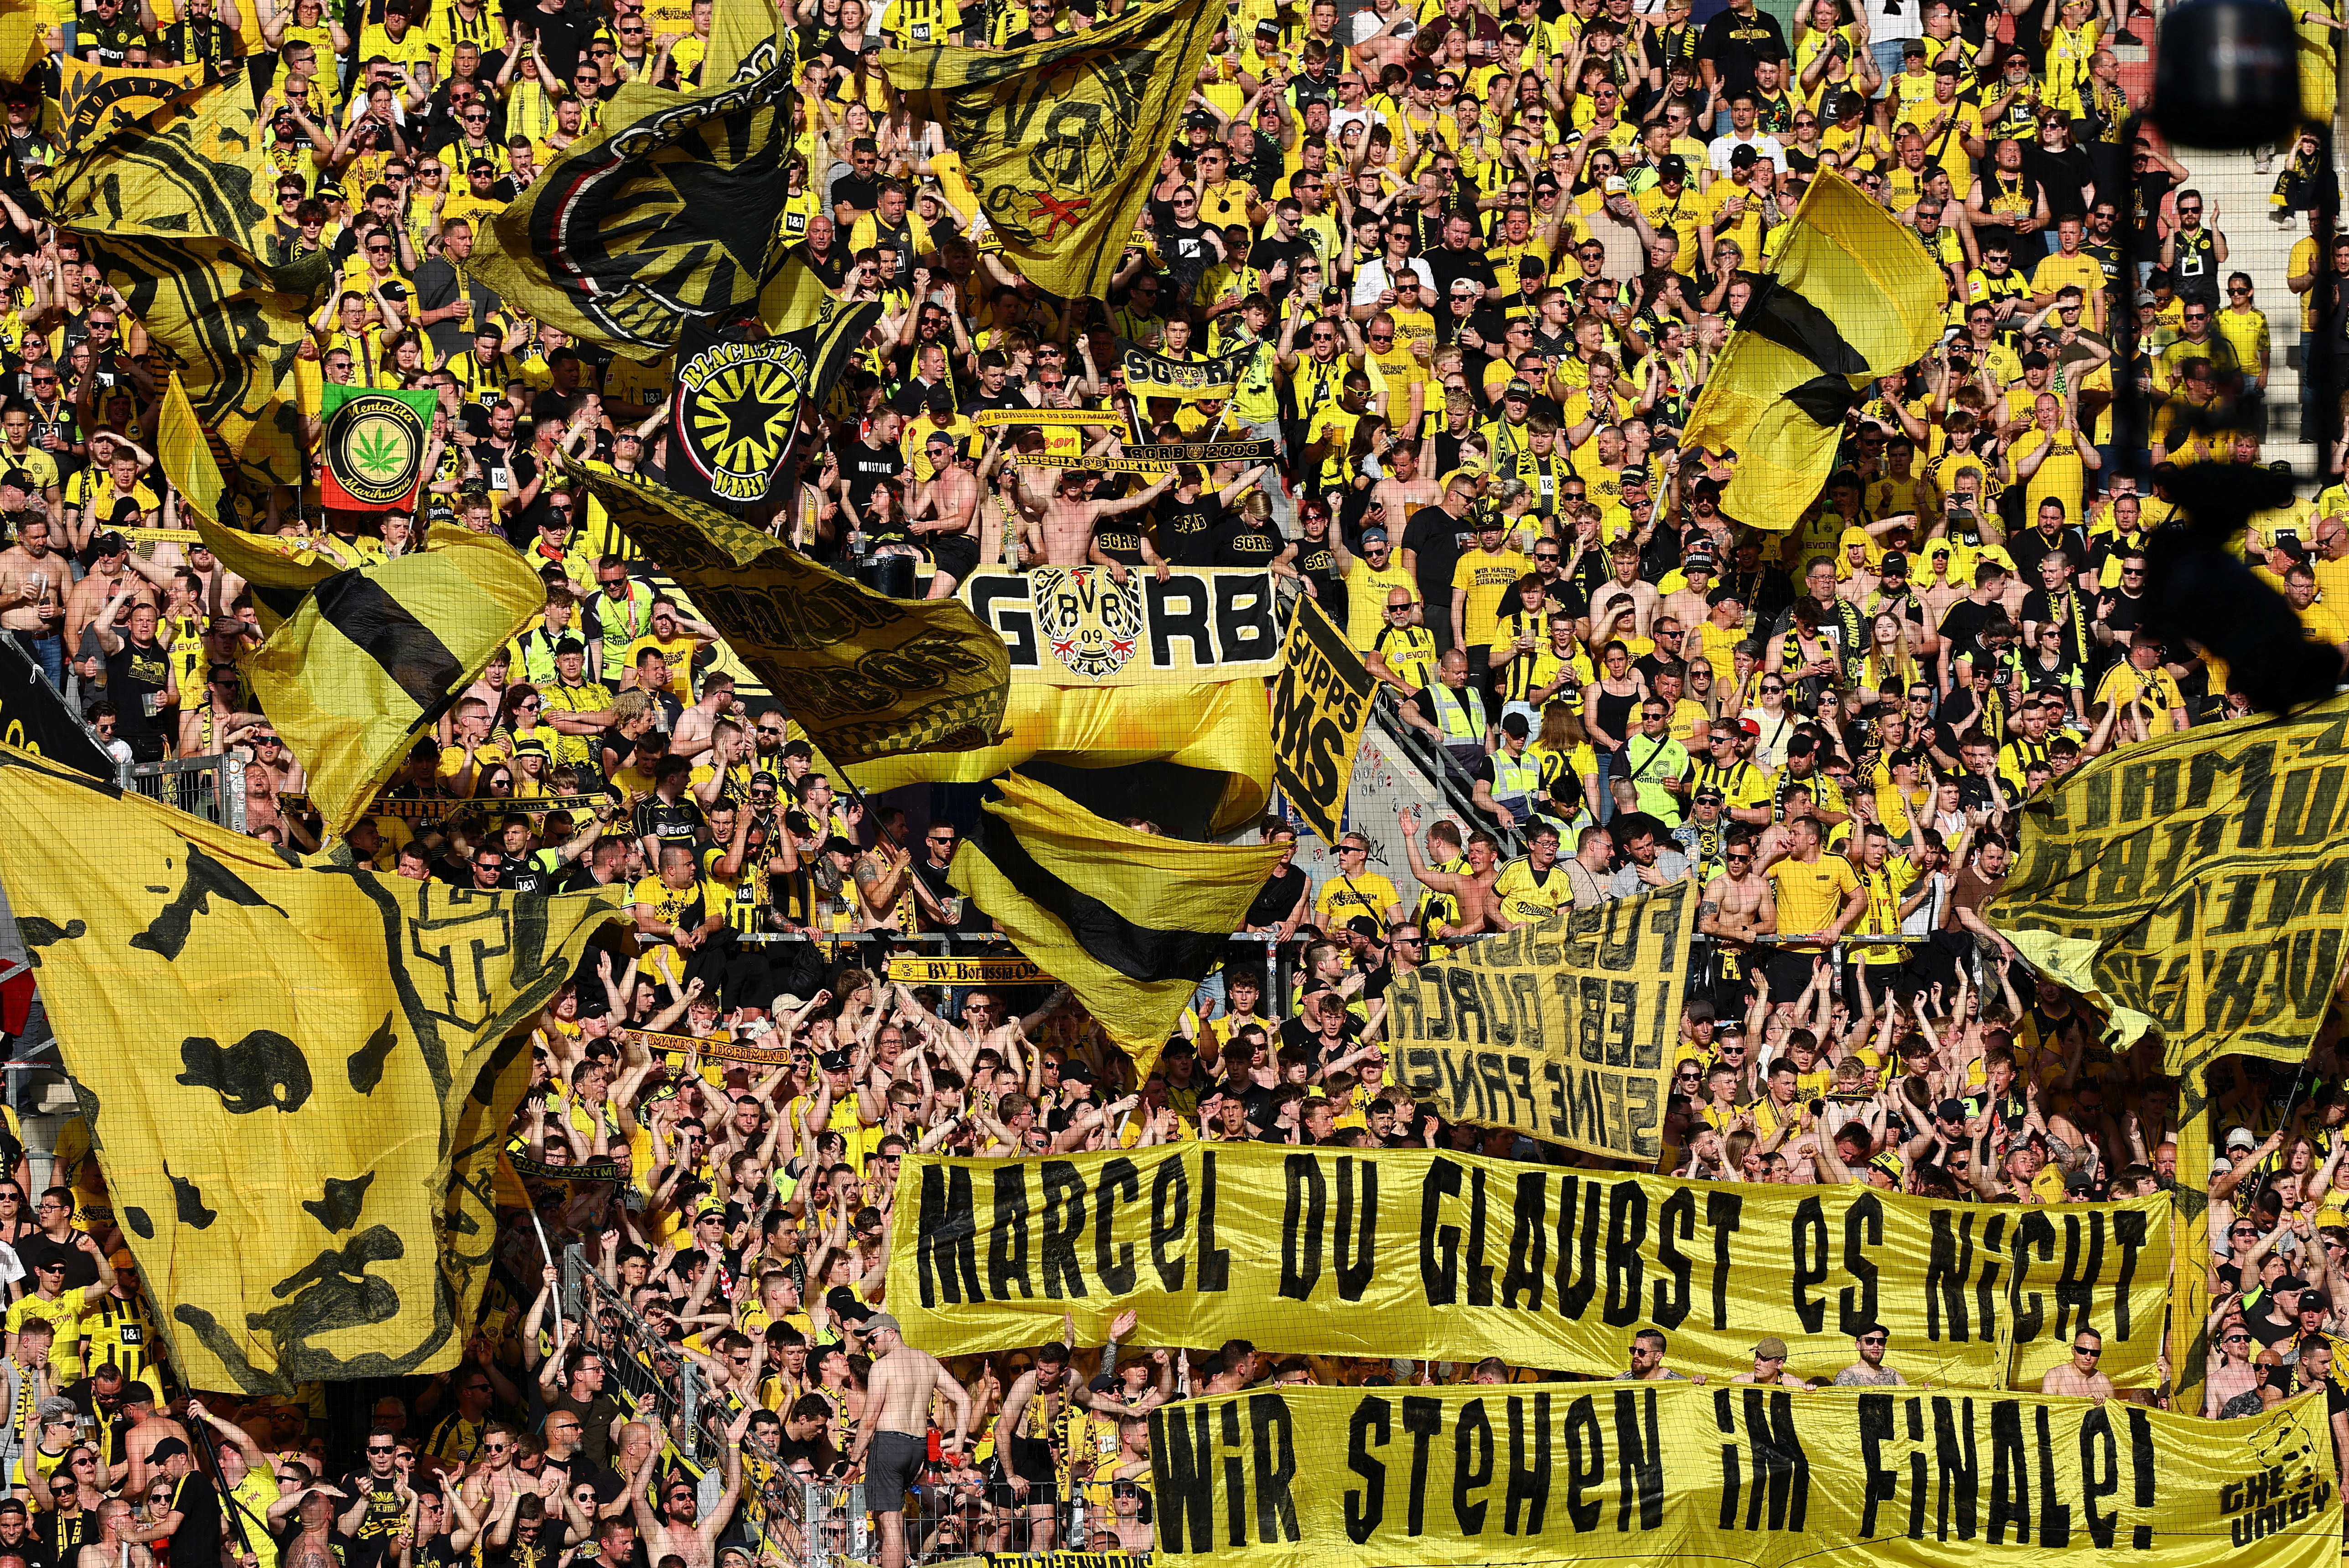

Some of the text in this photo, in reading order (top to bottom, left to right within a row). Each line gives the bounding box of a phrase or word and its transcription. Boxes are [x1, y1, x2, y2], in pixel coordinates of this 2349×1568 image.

[913, 27, 929, 37] 1&1
[788, 215, 804, 229] 1&1
[481, 396, 497, 407] 1&1
[644, 393, 661, 403] 1&1
[993, 411, 1045, 420] BORUSSIA
[1131, 443, 1259, 460] SGRB 2006
[859, 461, 891, 474] MUSTANG
[714, 471, 768, 498] WERL
[1100, 532, 1139, 550] SGRB
[1232, 535, 1273, 552] SGRB
[1081, 629, 1102, 644] 09
[1288, 625, 1362, 734] SUPPS
[1273, 664, 1345, 807] MS
[518, 879, 536, 892] 1&1
[738, 887, 752, 899] 1&1
[1517, 901, 1552, 917] Borussia
[927, 962, 952, 980] BV.
[956, 962, 1014, 981] Borussia
[1015, 962, 1040, 980] 09
[715, 1044, 788, 1062] DORTMUND
[1278, 1153, 1377, 1302] DU
[1420, 1156, 1743, 1331] GLAUBST
[124, 1328, 141, 1341] 1&1
